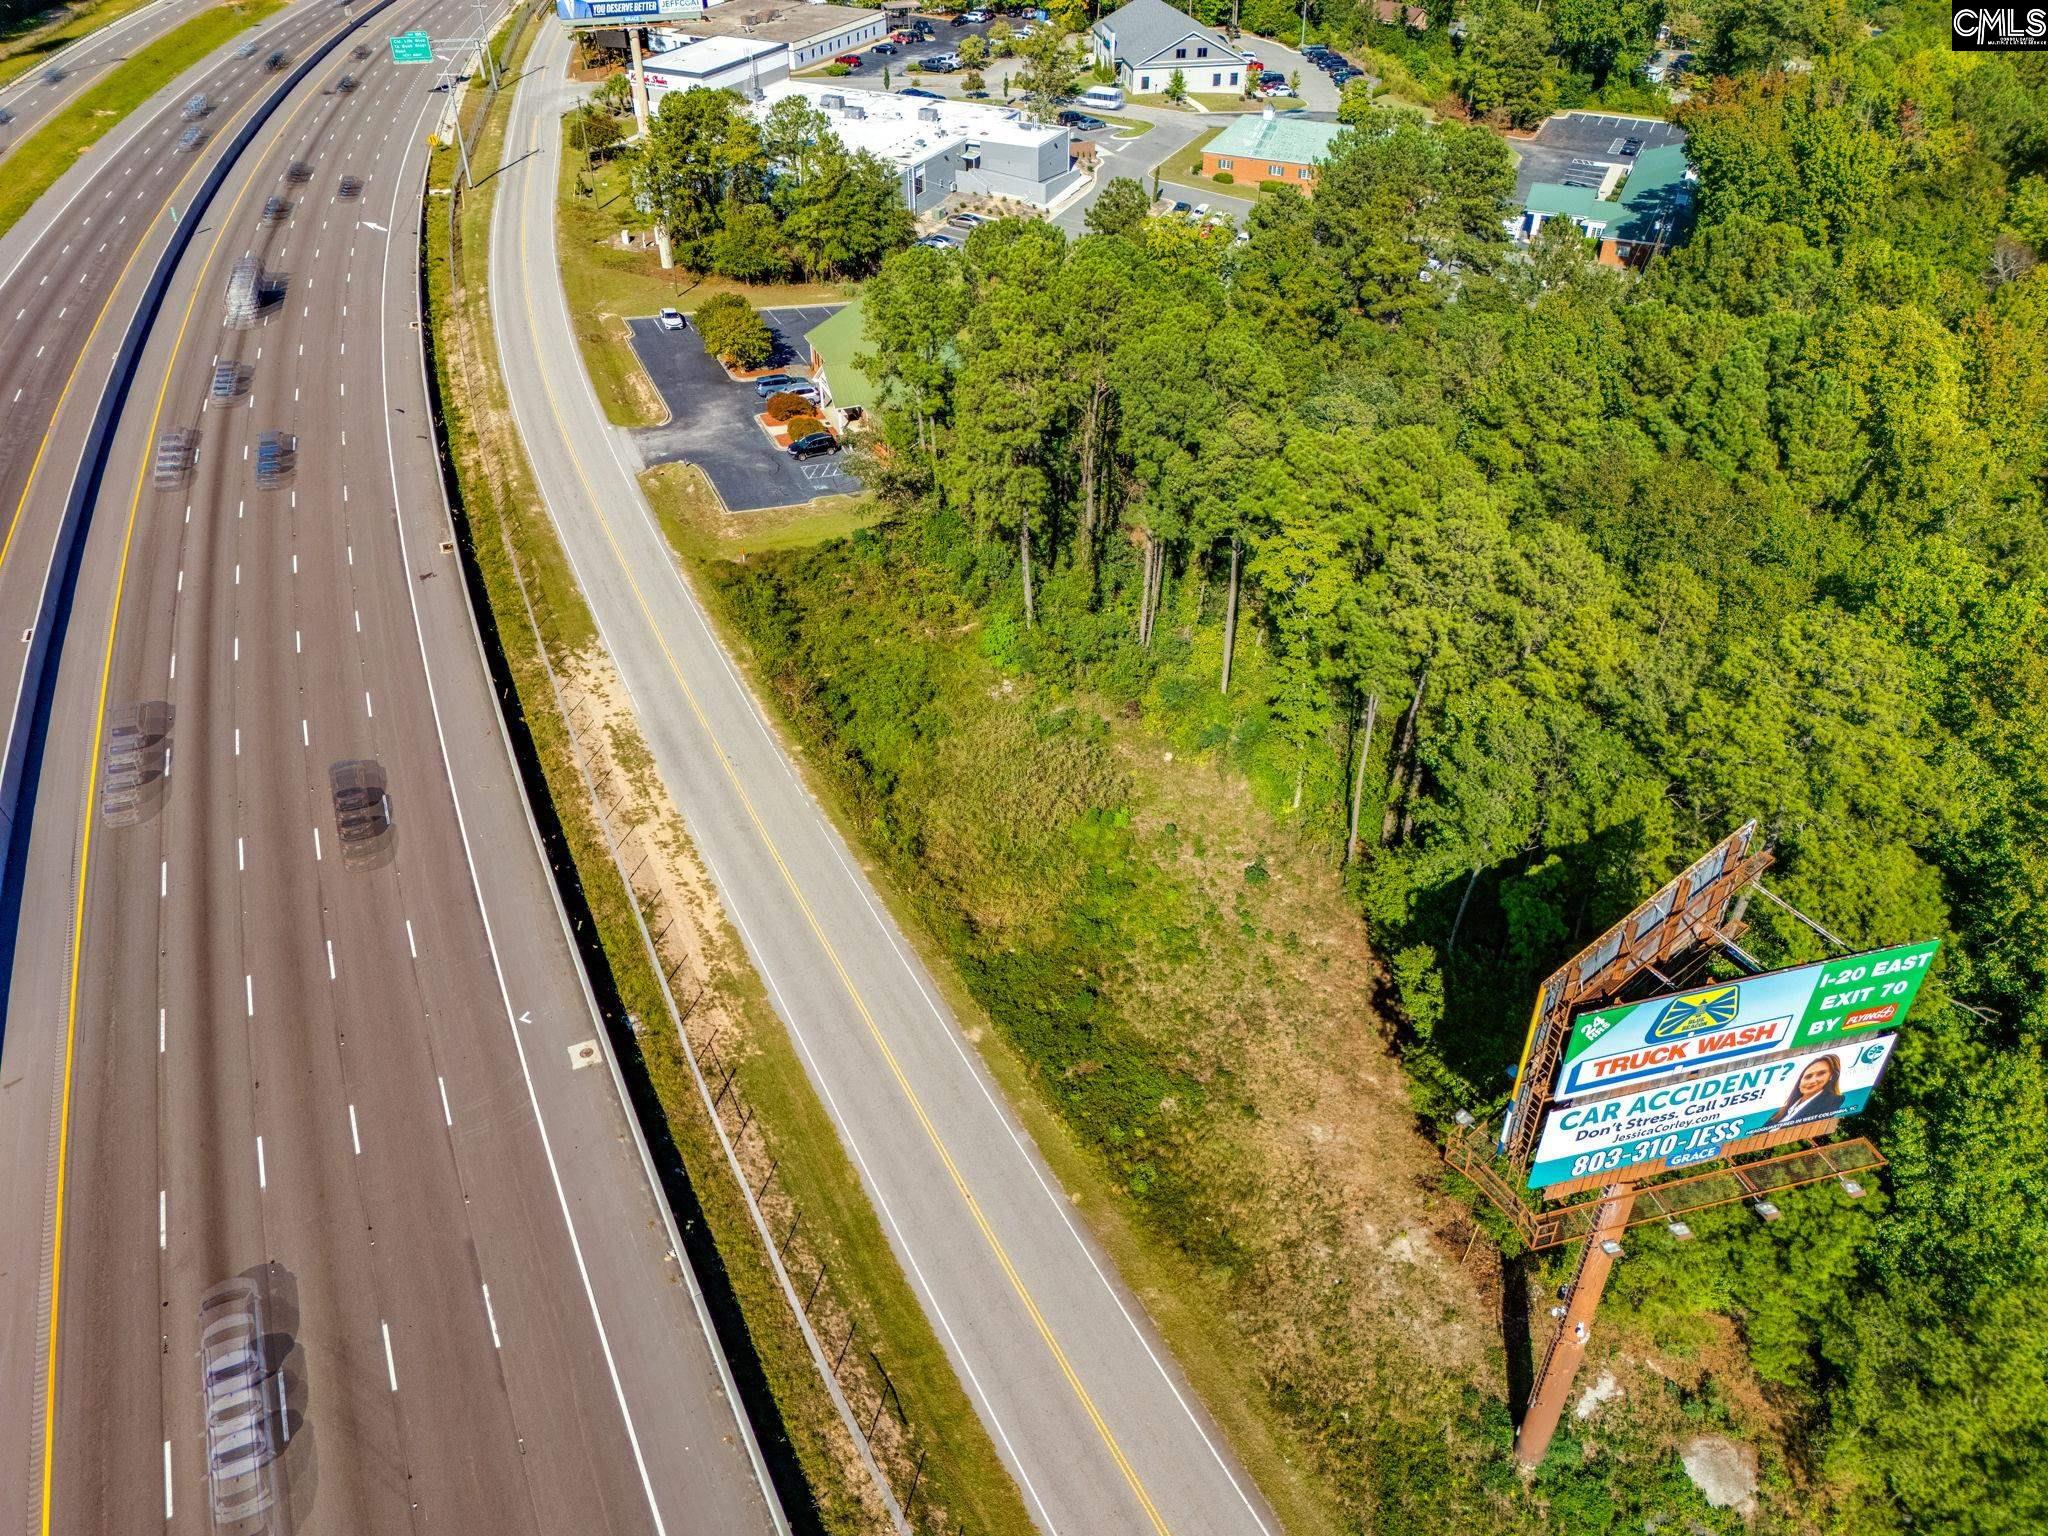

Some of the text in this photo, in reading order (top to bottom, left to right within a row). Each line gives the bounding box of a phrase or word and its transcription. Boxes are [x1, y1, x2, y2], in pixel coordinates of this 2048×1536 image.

[593, 1, 657, 14] YOU DESERVE BETTER
[1820, 952, 1934, 988] I-20 EAST
[1820, 980, 1909, 1010] EXIT 70
[1580, 1016, 1606, 1034] 24
[1585, 1022, 1611, 1041] HRS
[1807, 1016, 1841, 1036] BY
[1594, 1023, 1778, 1077] TRUCK WASH
[1559, 1062, 1796, 1131] CAR ACCIDENT?
[1575, 1088, 1766, 1141] Don't Stress. Call JESS!
[1612, 1113, 1721, 1143] JessicaCorley.com
[1571, 1118, 1745, 1177] 803-310-JESS
[1670, 1146, 1717, 1165] GRACE
